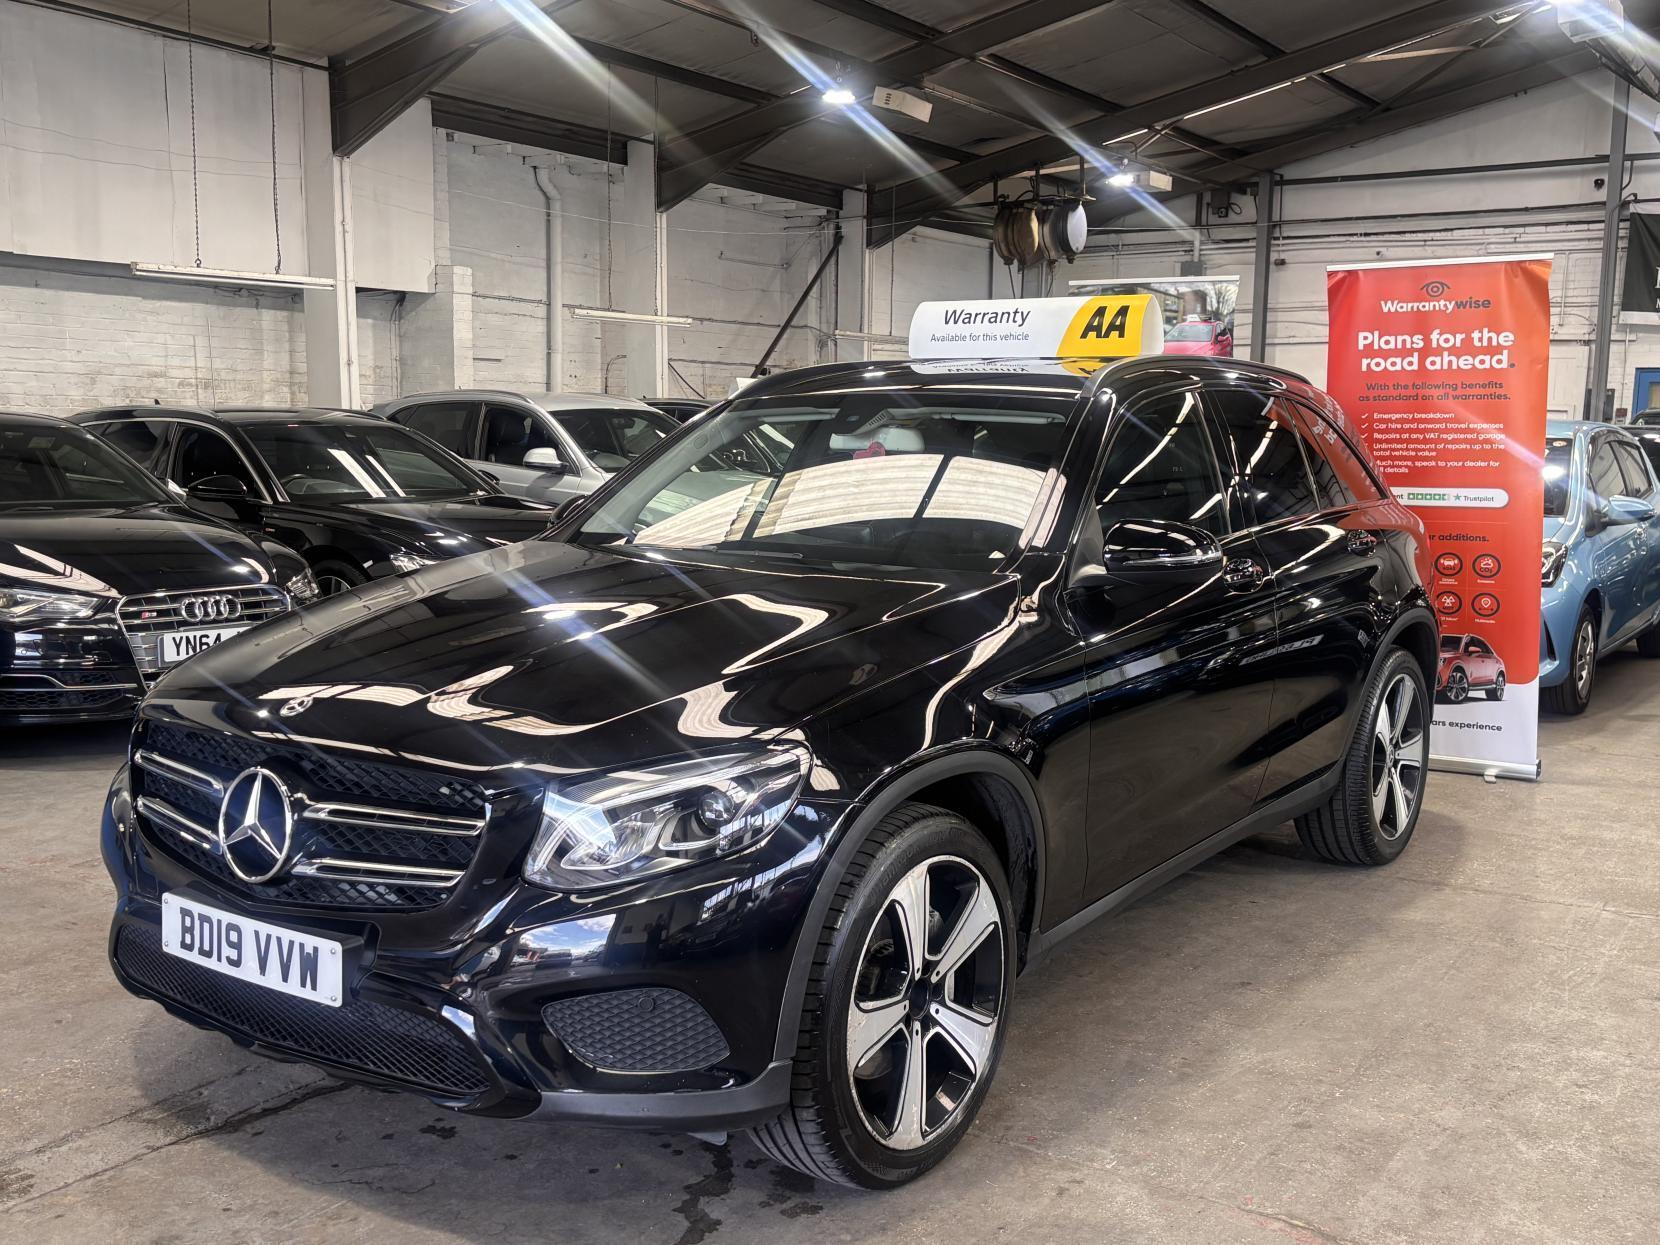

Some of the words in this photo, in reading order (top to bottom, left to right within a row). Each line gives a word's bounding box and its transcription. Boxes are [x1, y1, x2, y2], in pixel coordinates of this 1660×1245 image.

[1381, 297, 1491, 314] Warrantywise
[944, 307, 1031, 327] Warranty
[1080, 304, 1130, 339] AA
[930, 332, 967, 342] Available
[968, 332, 982, 342] for
[982, 332, 998, 342] this
[999, 332, 1030, 341] vehicle
[1358, 330, 1424, 350] Plans
[1430, 329, 1465, 348] for
[1472, 328, 1514, 346] the
[1361, 352, 1418, 372] road
[1425, 350, 1516, 370] ahead.
[1366, 382, 1390, 390] With
[1392, 382, 1409, 390] the
[1412, 382, 1458, 392] following
[1461, 380, 1504, 390] benefits
[1372, 393, 1418, 402] standard
[1437, 392, 1449, 400] all
[1452, 392, 1511, 400] warranties.
[1438, 533, 1489, 542] additions.
[1448, 721, 1503, 732] experience
[180, 906, 242, 968] BD19
[254, 930, 319, 992] VVW
